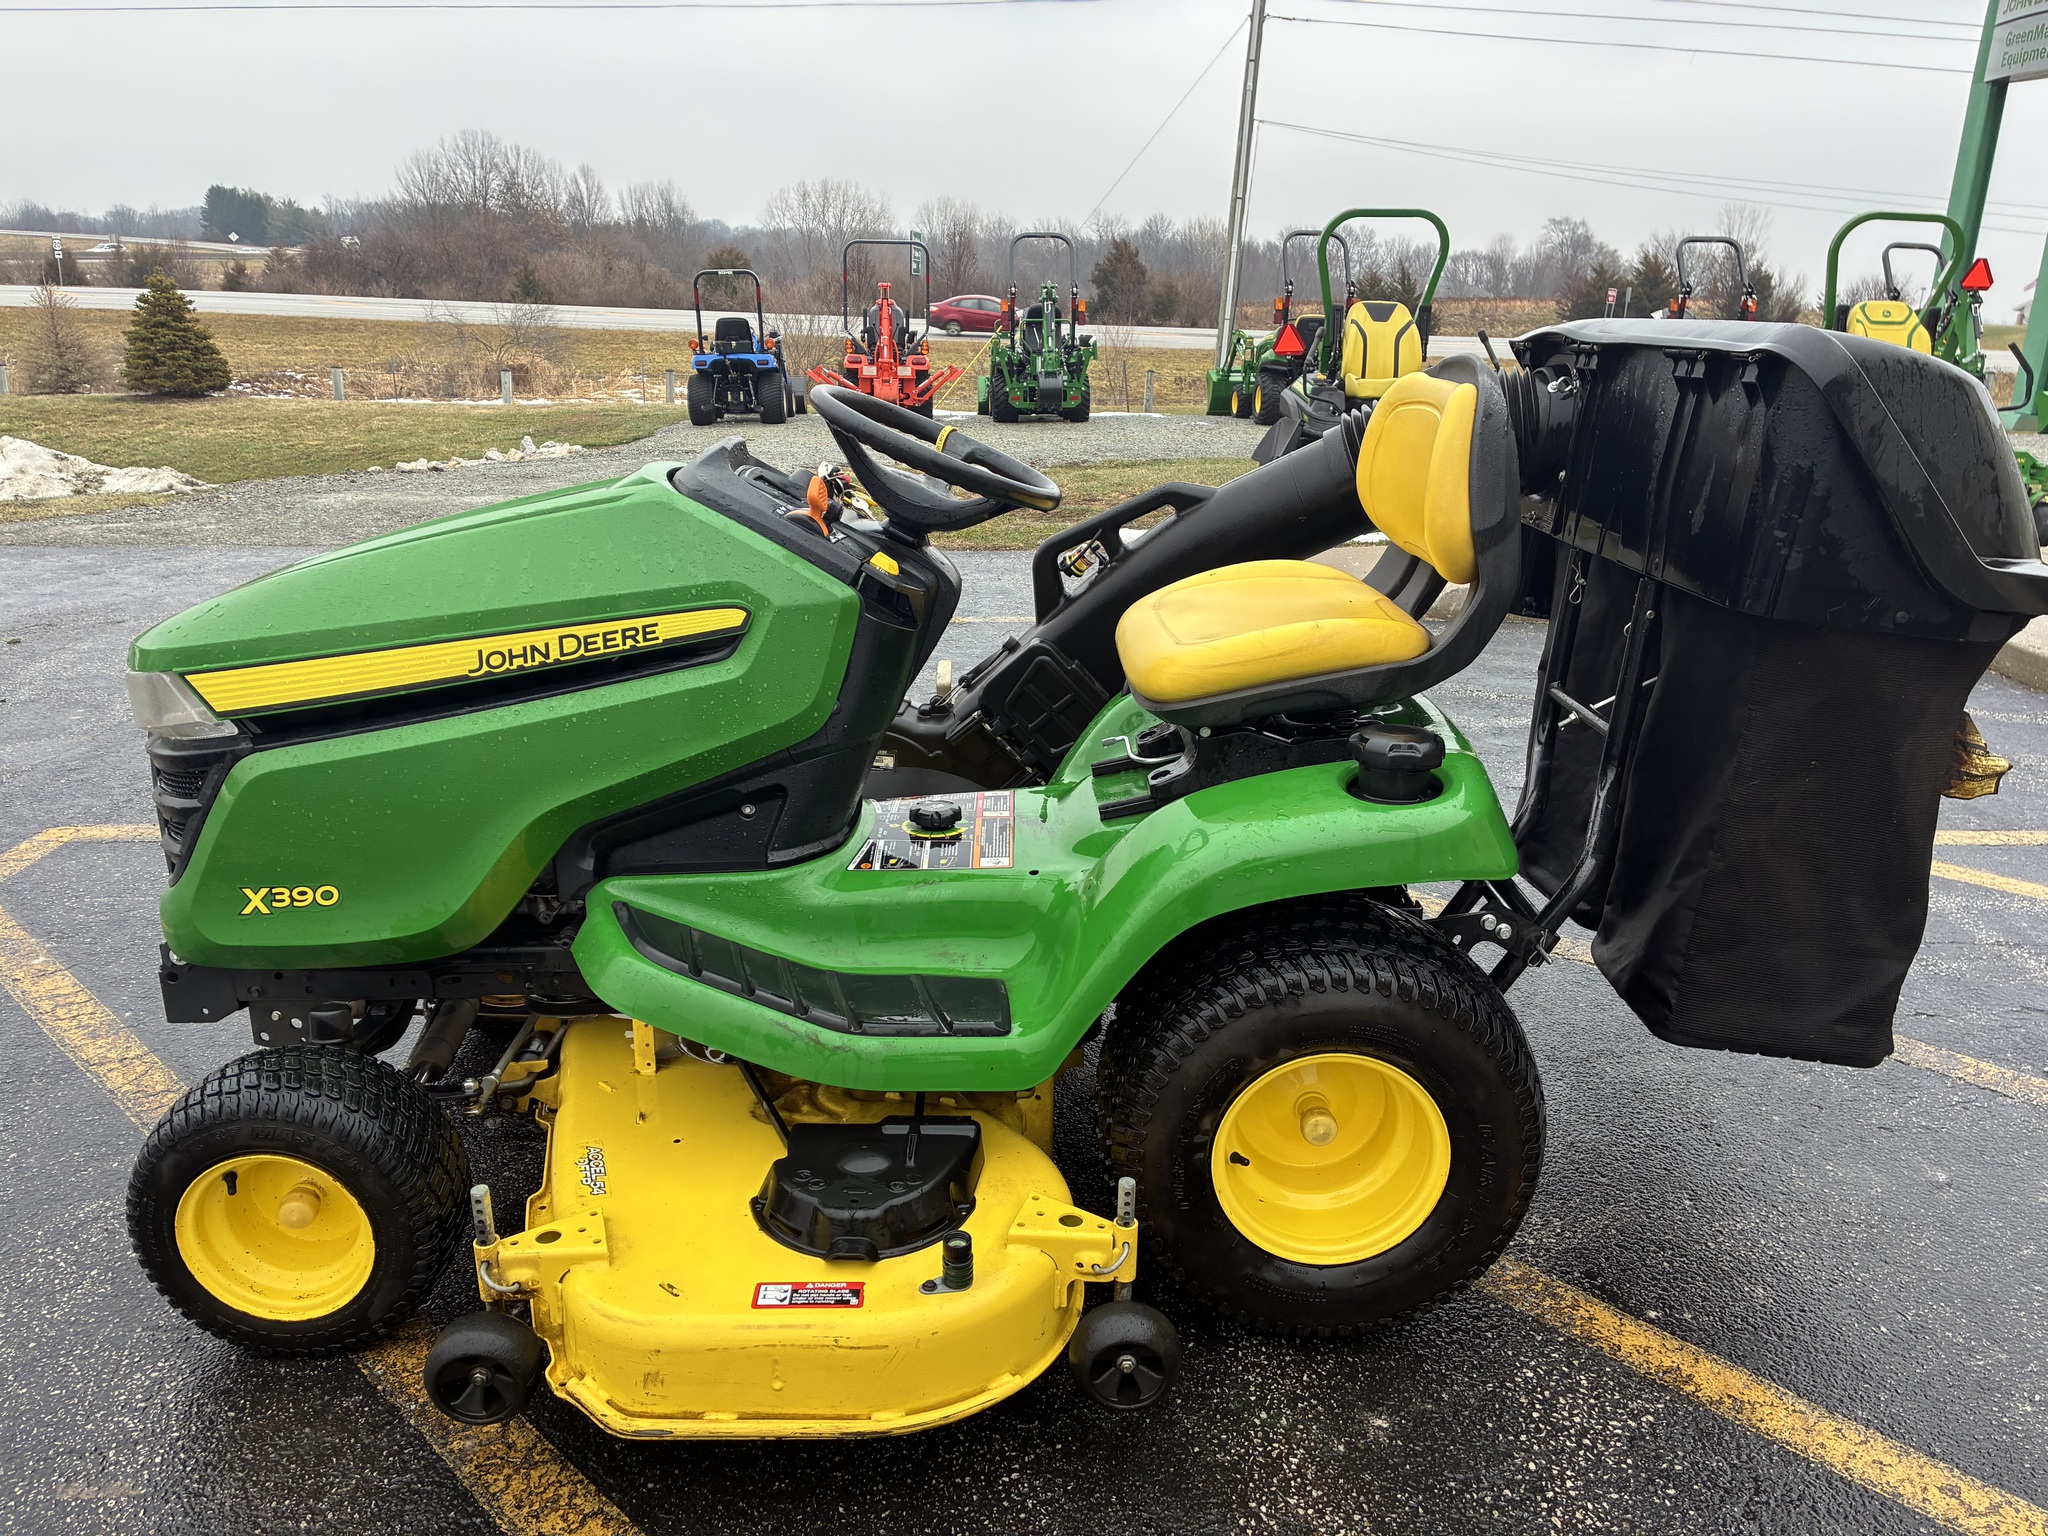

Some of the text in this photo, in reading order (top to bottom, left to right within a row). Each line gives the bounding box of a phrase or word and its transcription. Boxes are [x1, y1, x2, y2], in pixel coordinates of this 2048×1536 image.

[2000, 47, 2048, 70] Equipme
[467, 622, 661, 674] JOHN DEERE
[237, 884, 340, 915] X390
[586, 1146, 607, 1195] ACCEL 54
